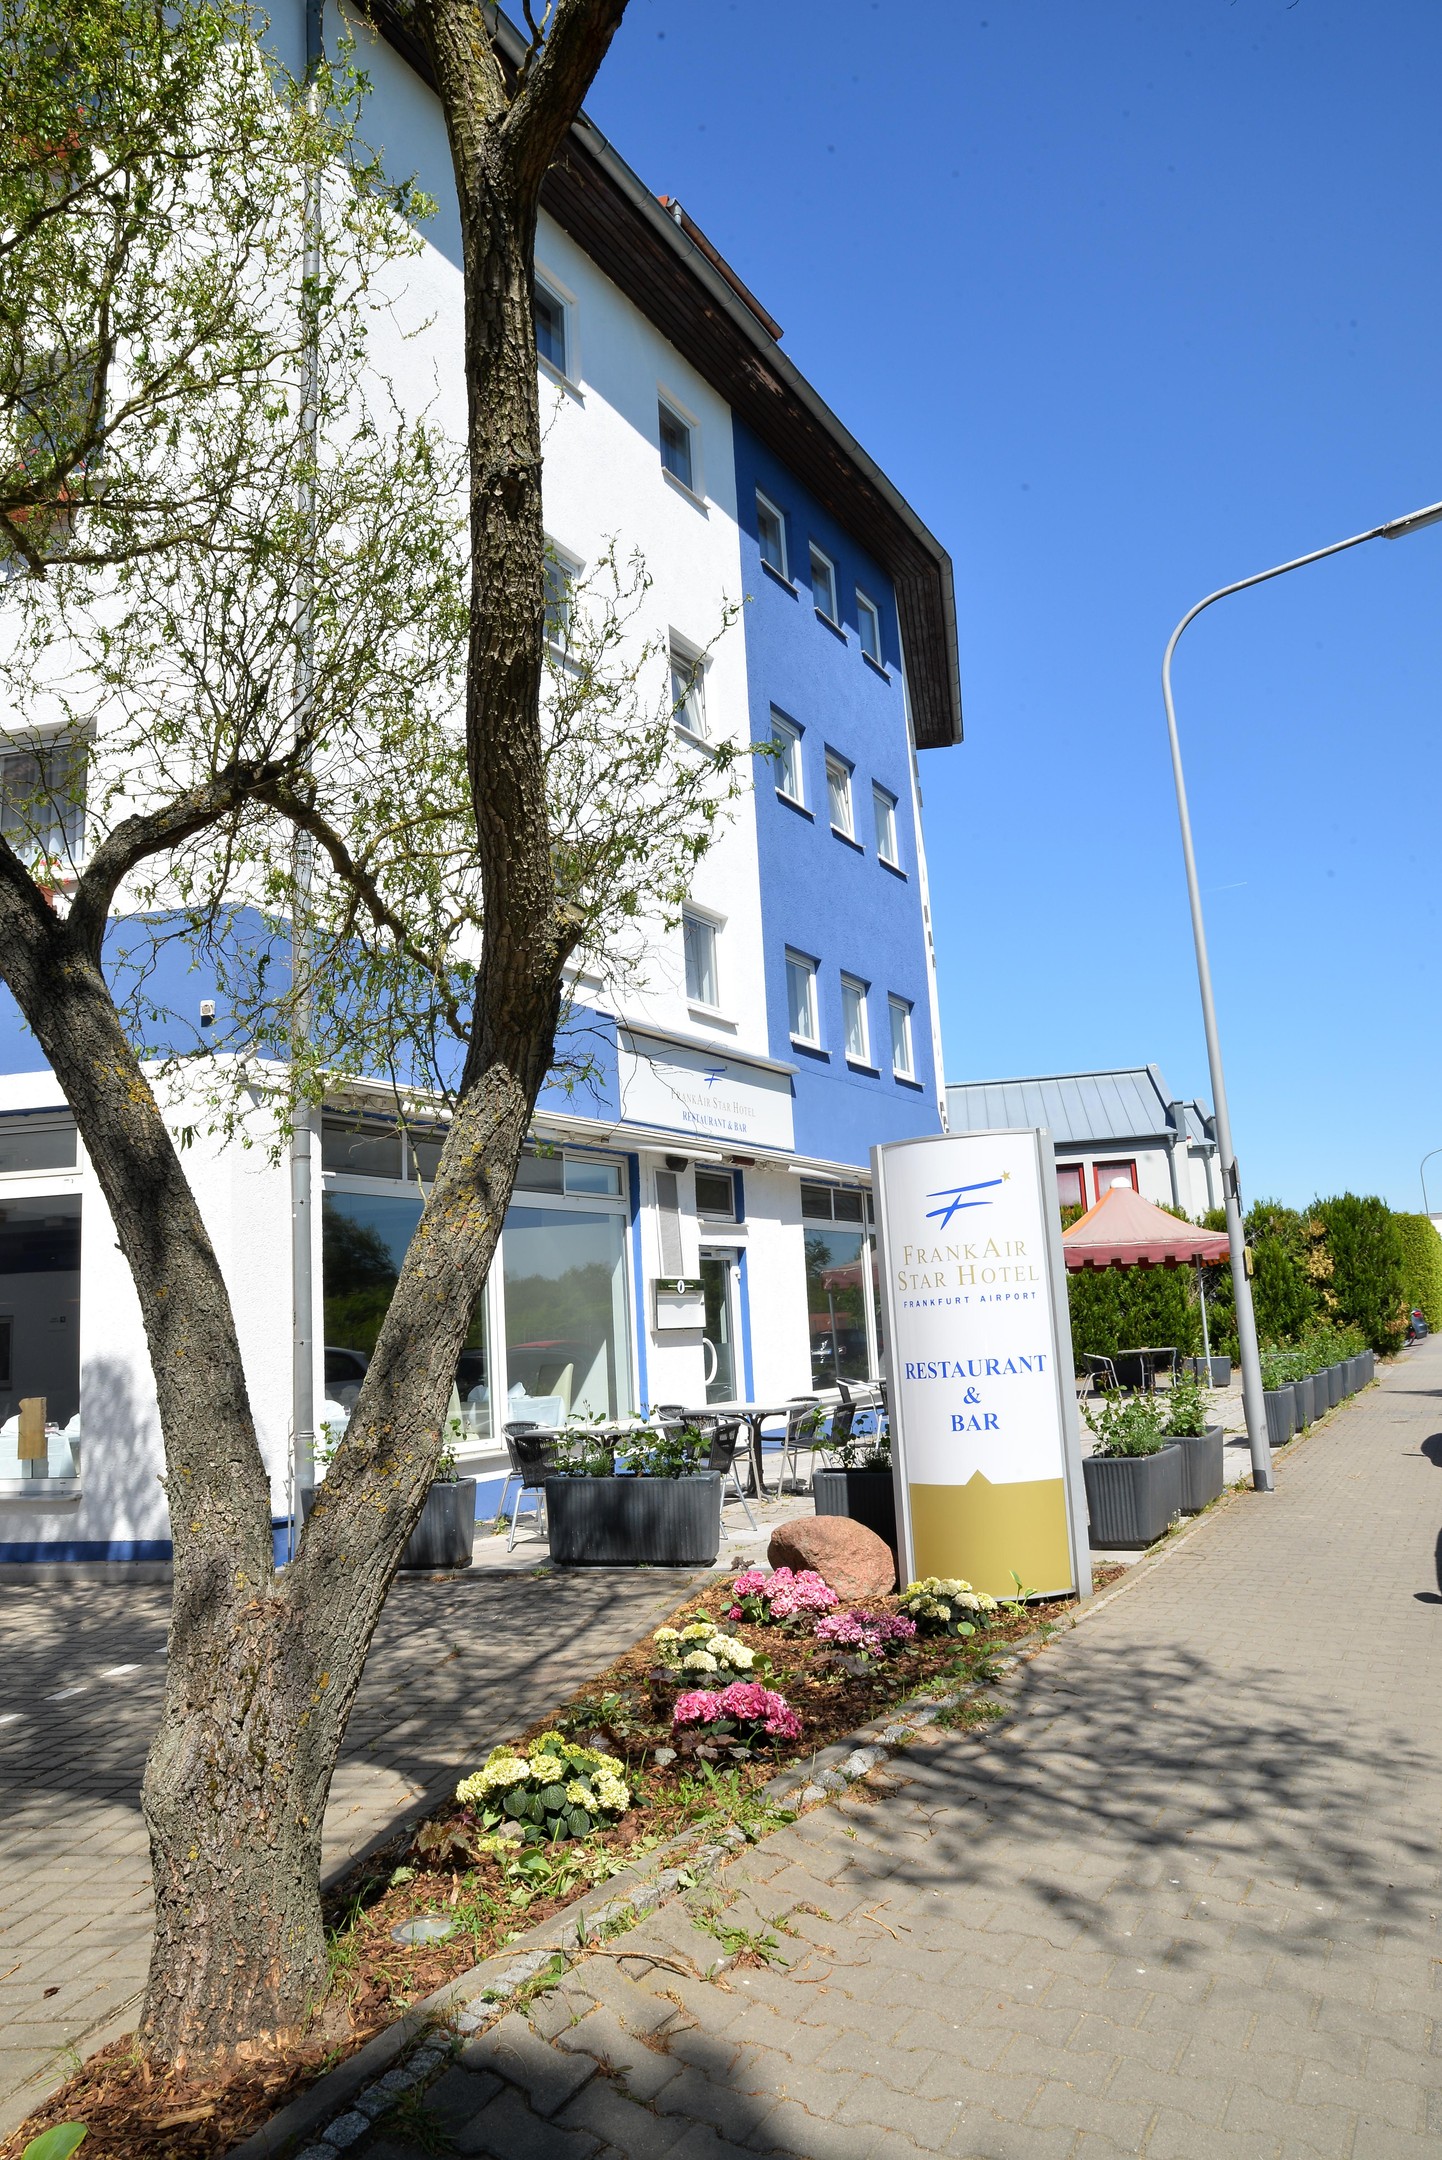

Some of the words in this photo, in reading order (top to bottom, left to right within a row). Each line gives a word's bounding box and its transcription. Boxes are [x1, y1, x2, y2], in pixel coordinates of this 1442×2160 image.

[713, 1097, 731, 1112] STAR
[733, 1102, 756, 1117] HOTEL
[682, 1111, 726, 1128] RESTAURANT
[727, 1121, 733, 1130] &
[734, 1121, 747, 1132] BAR
[898, 1270, 946, 1291] STAR
[958, 1264, 1039, 1286] HOTEL
[903, 1296, 970, 1308] FRANKFURT
[980, 1291, 1037, 1303] AIRPORT
[905, 1354, 1047, 1380] RESTAURANT
[963, 1386, 981, 1404] &
[951, 1412, 1000, 1432] BAR
